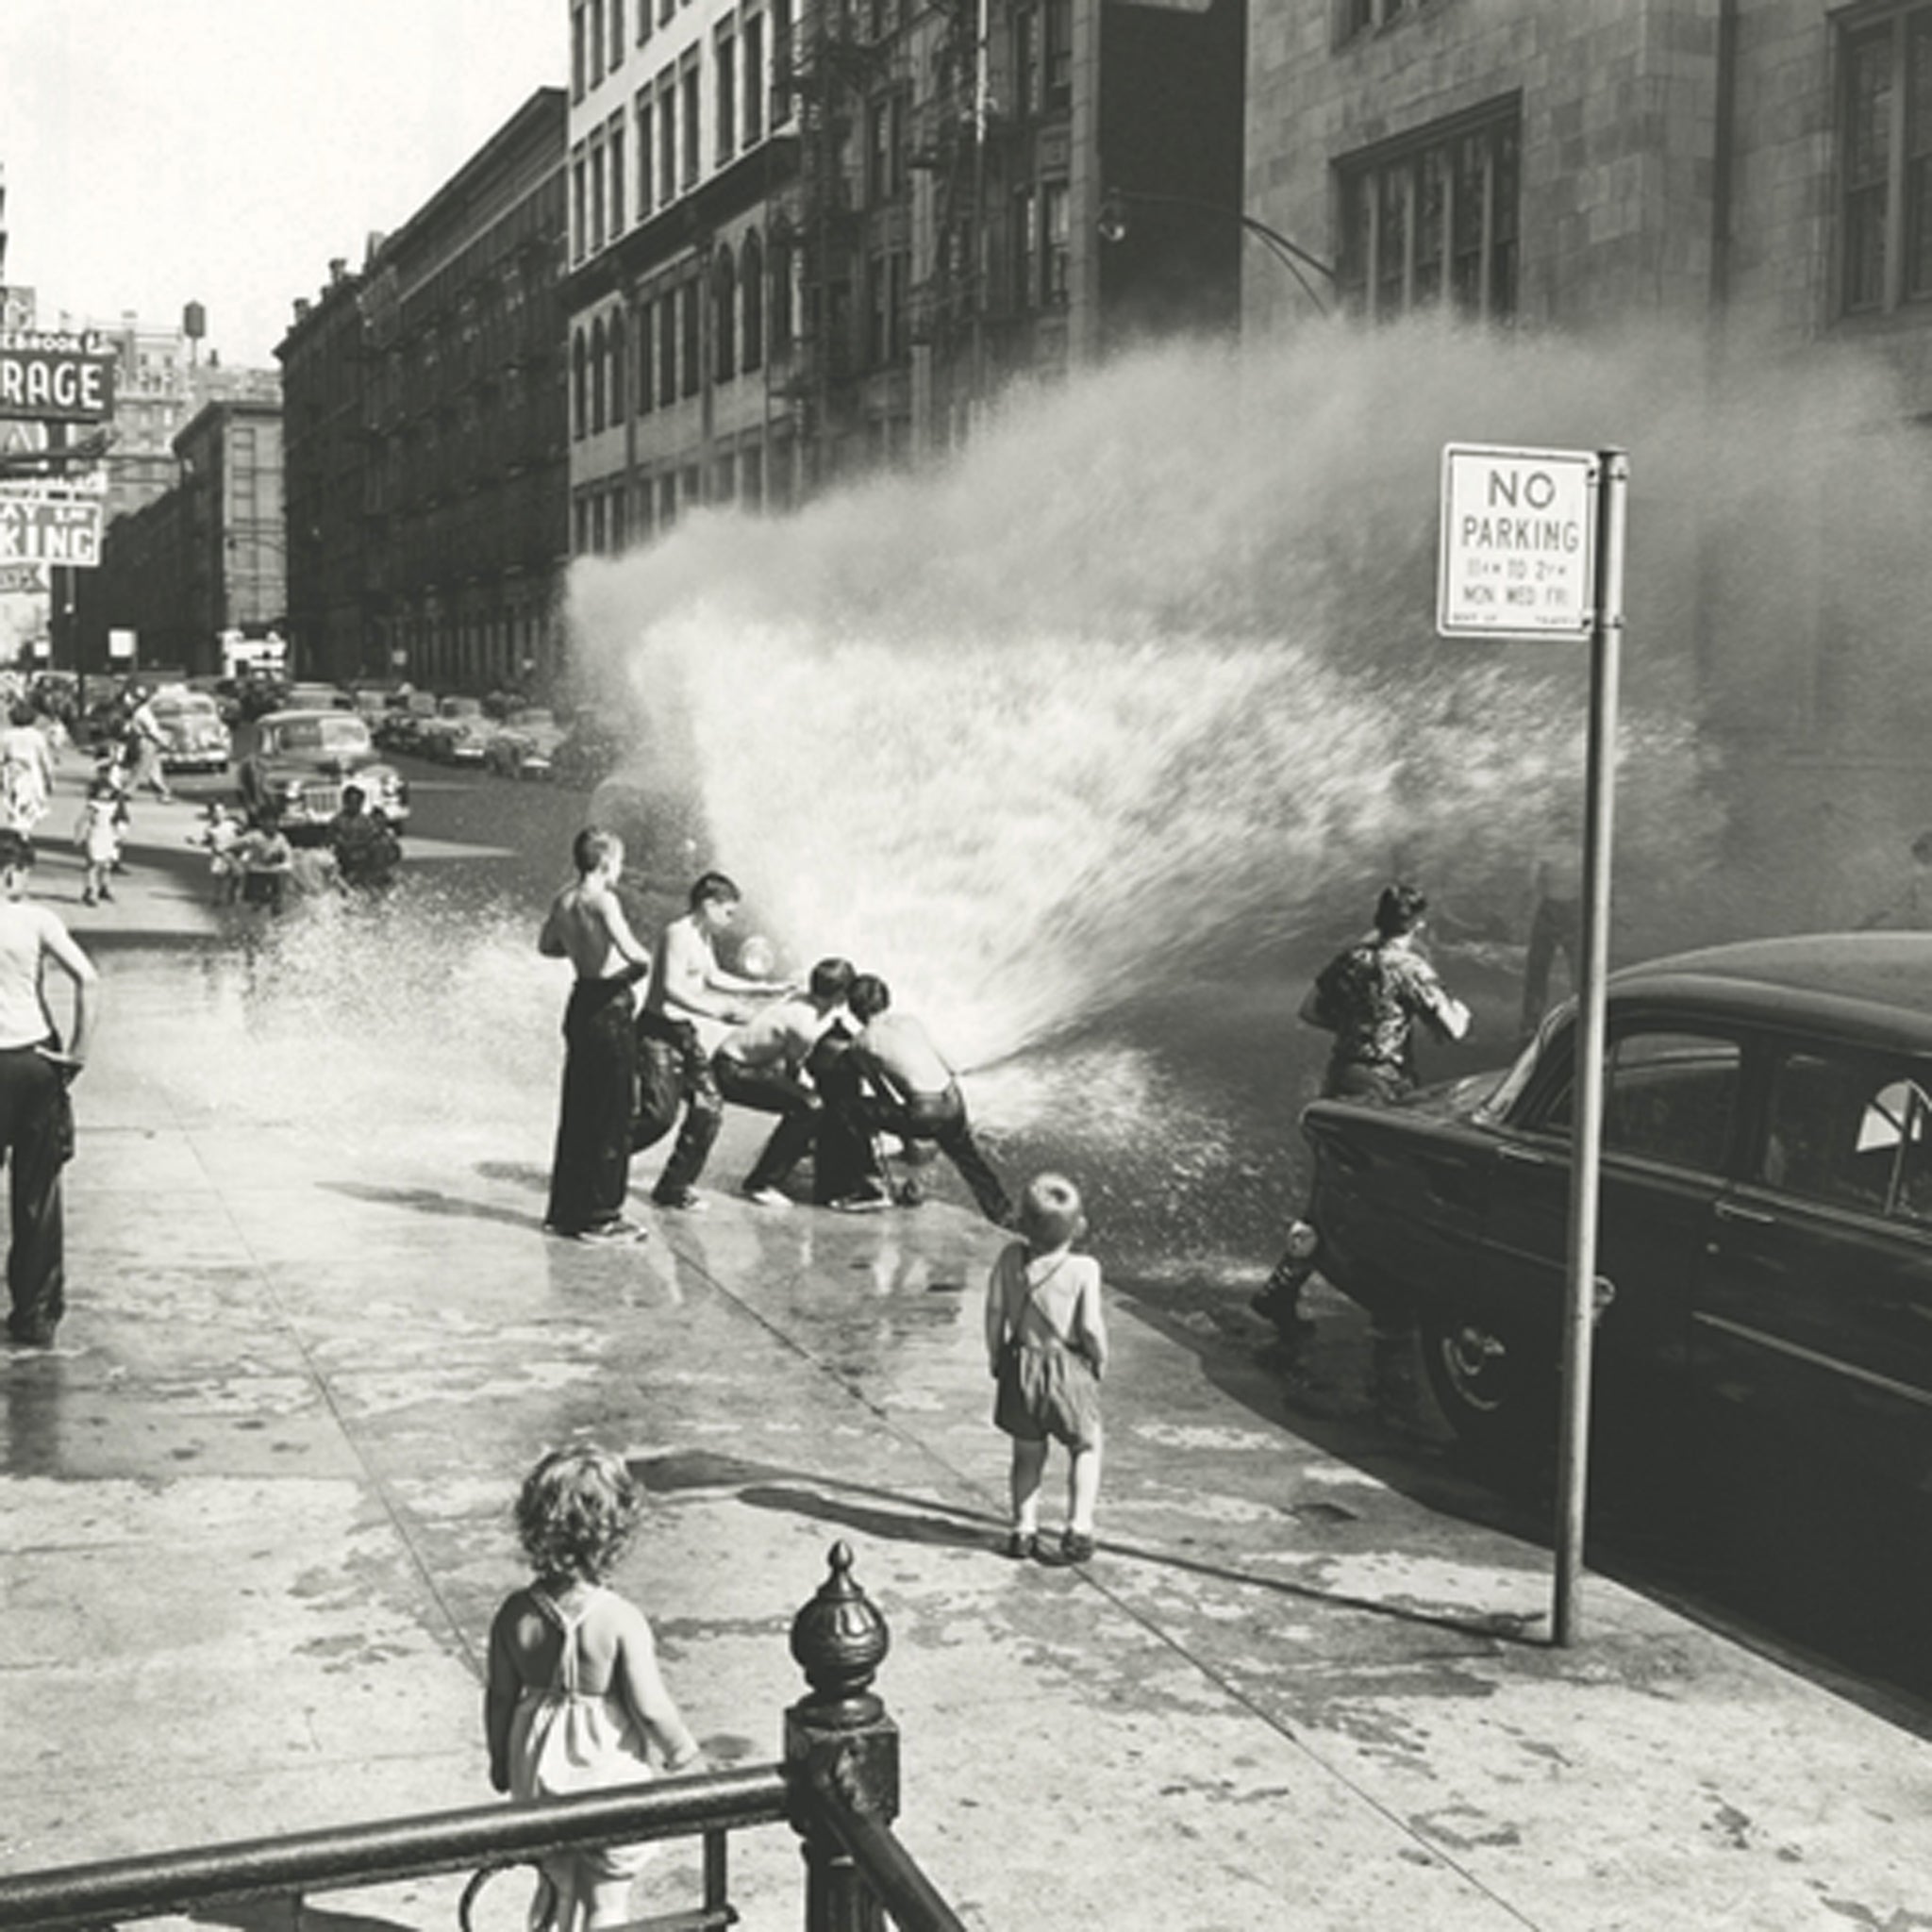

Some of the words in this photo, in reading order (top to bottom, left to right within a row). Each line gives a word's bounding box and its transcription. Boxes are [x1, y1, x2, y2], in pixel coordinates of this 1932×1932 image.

[3, 359, 104, 408] RAGE
[1488, 470, 1555, 510] NO
[0, 525, 93, 565] KING
[1461, 516, 1579, 554] PARKING
[1462, 585, 1495, 605] MON
[1506, 586, 1536, 607] WED
[1546, 587, 1569, 607] FRI
